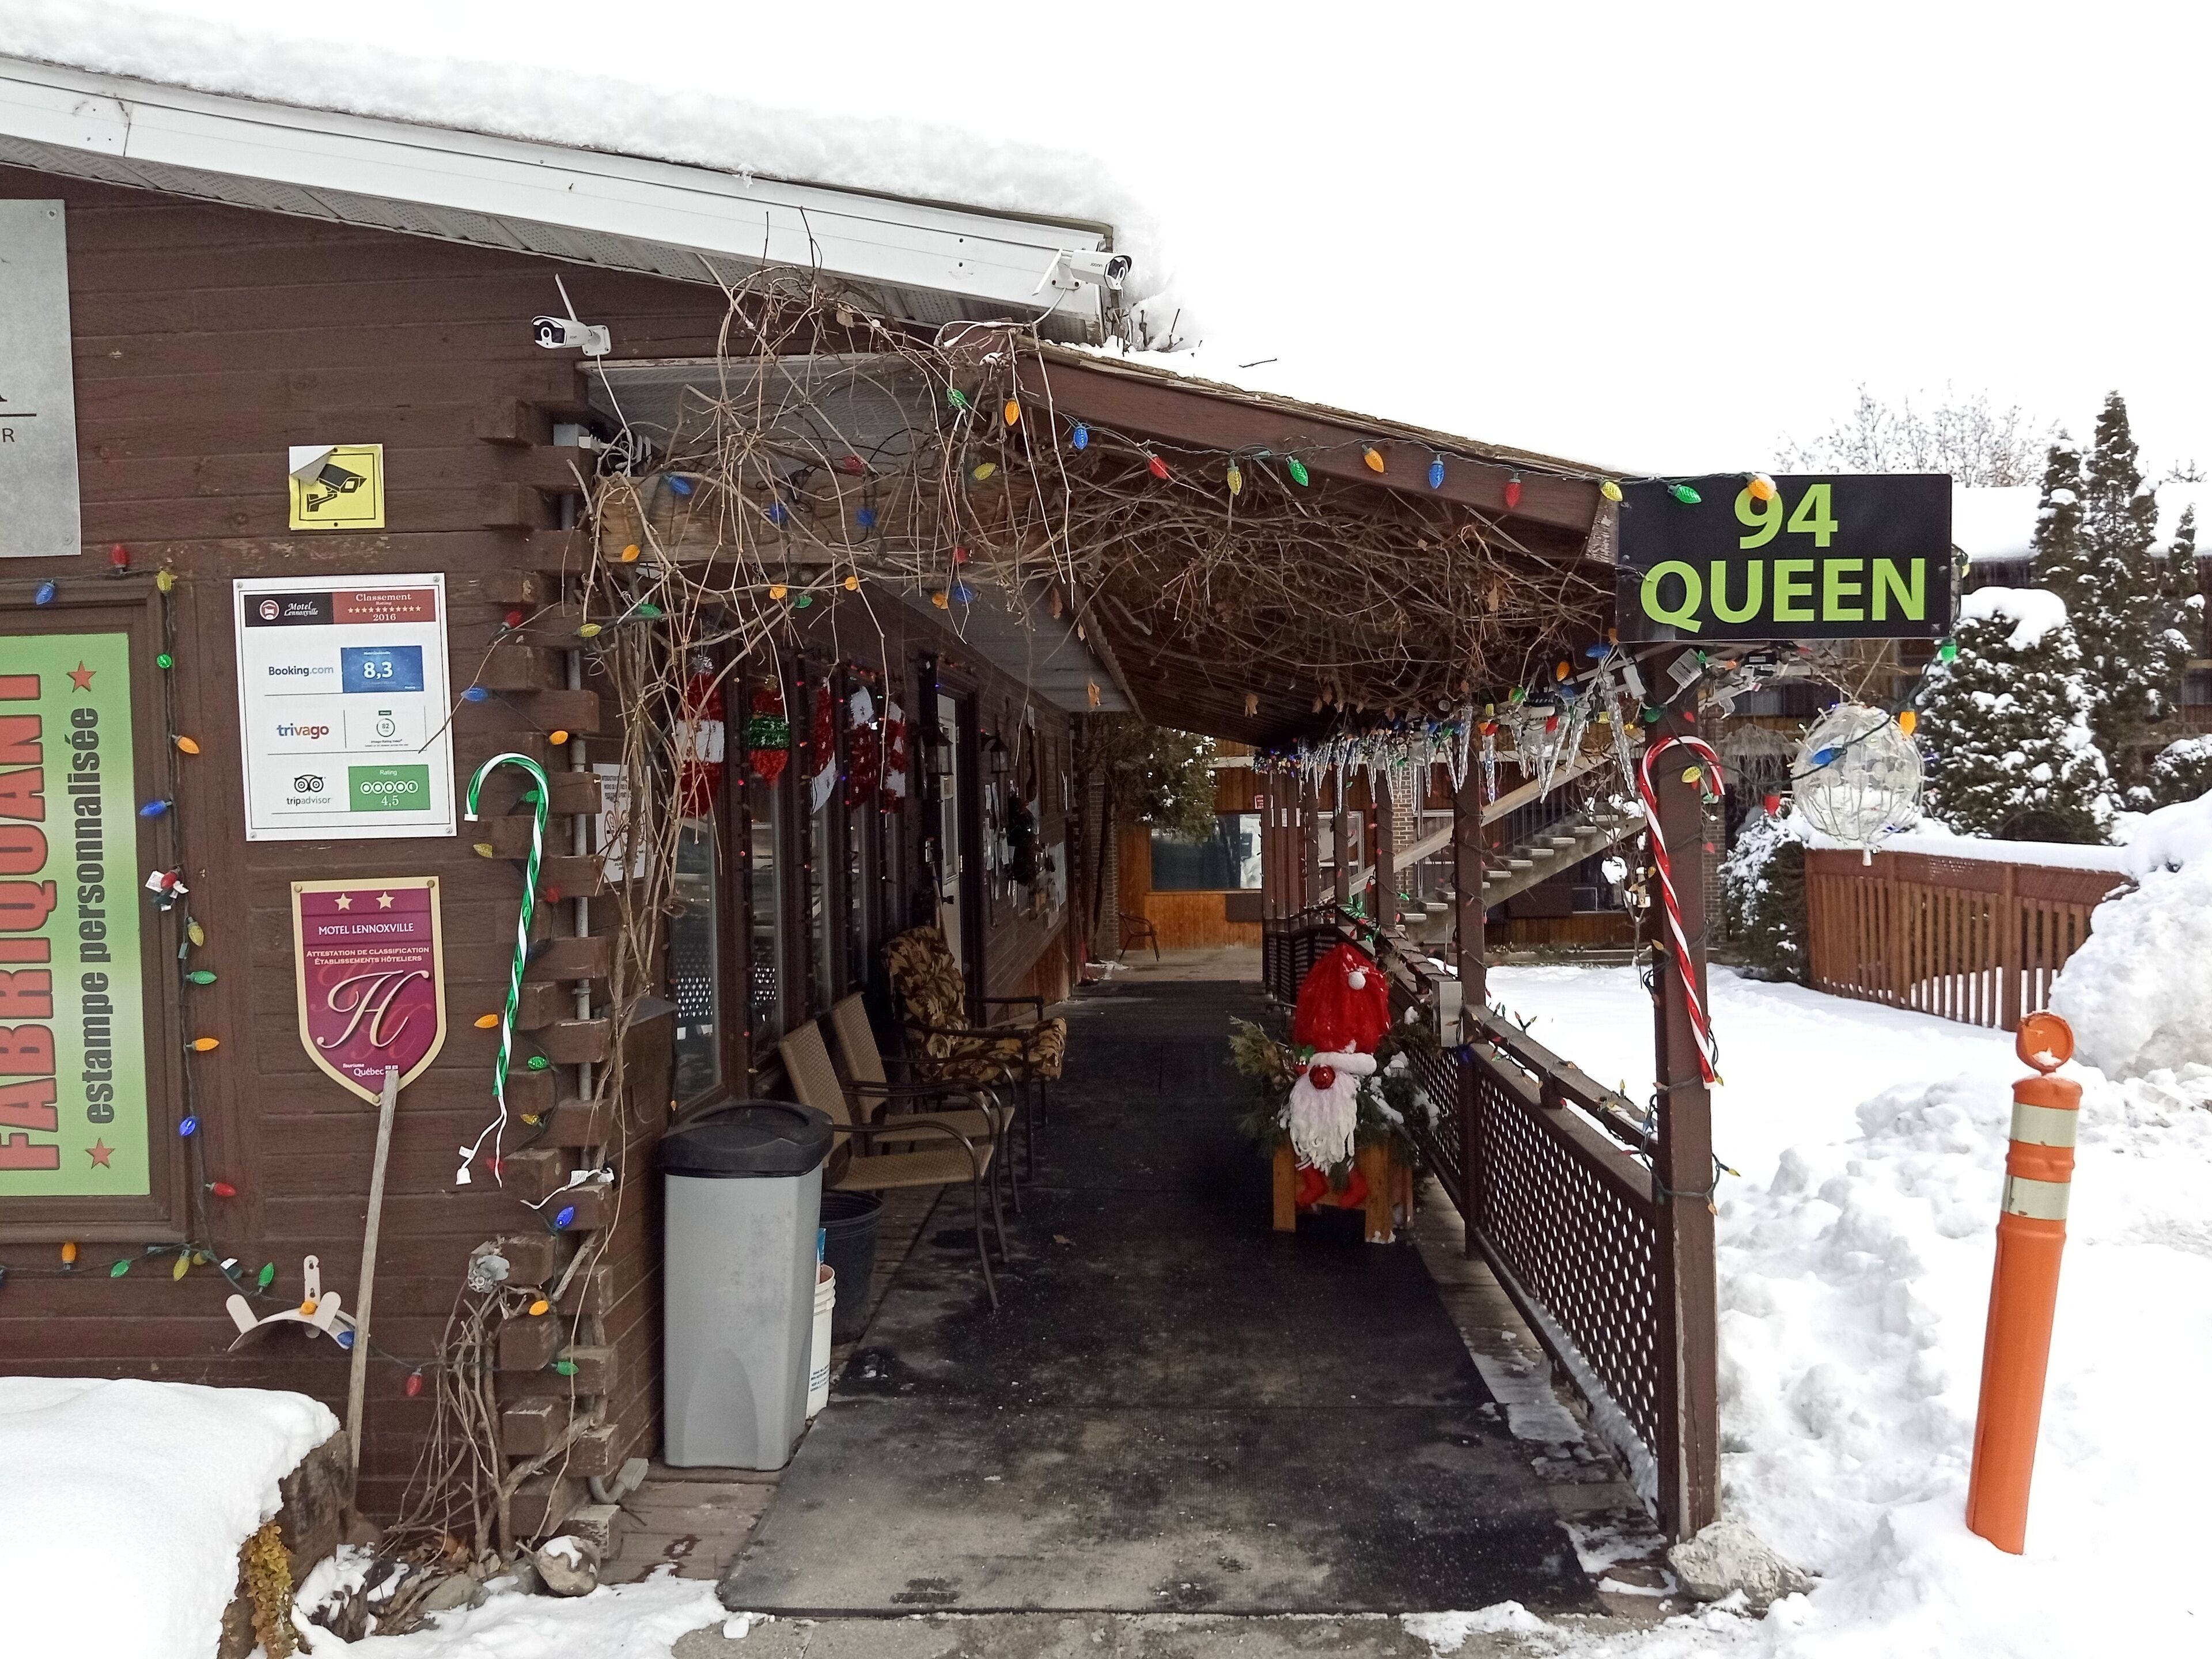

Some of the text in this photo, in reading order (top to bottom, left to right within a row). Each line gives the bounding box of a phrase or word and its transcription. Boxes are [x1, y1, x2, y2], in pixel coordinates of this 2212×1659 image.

[1734, 483, 1838, 550] 94
[356, 593, 412, 601] Classement
[1640, 558, 1925, 634] QUEEN
[288, 601, 313, 610] Motel
[373, 613, 396, 621] 2016
[268, 665, 334, 677] Booking.com
[363, 661, 393, 679] 8,3
[276, 723, 329, 740] trivago
[287, 796, 331, 806] tripadvisor
[381, 795, 399, 806] 4,5
[65, 707, 115, 1124] estampe personnalisée
[318, 923, 414, 935] MOTEL LENNOXVILLE
[369, 947, 429, 955] CLASSIFICATION
[315, 955, 422, 965] ÉTABLISSEMENTS HÔTELIERS
[354, 1067, 384, 1077] Québec
